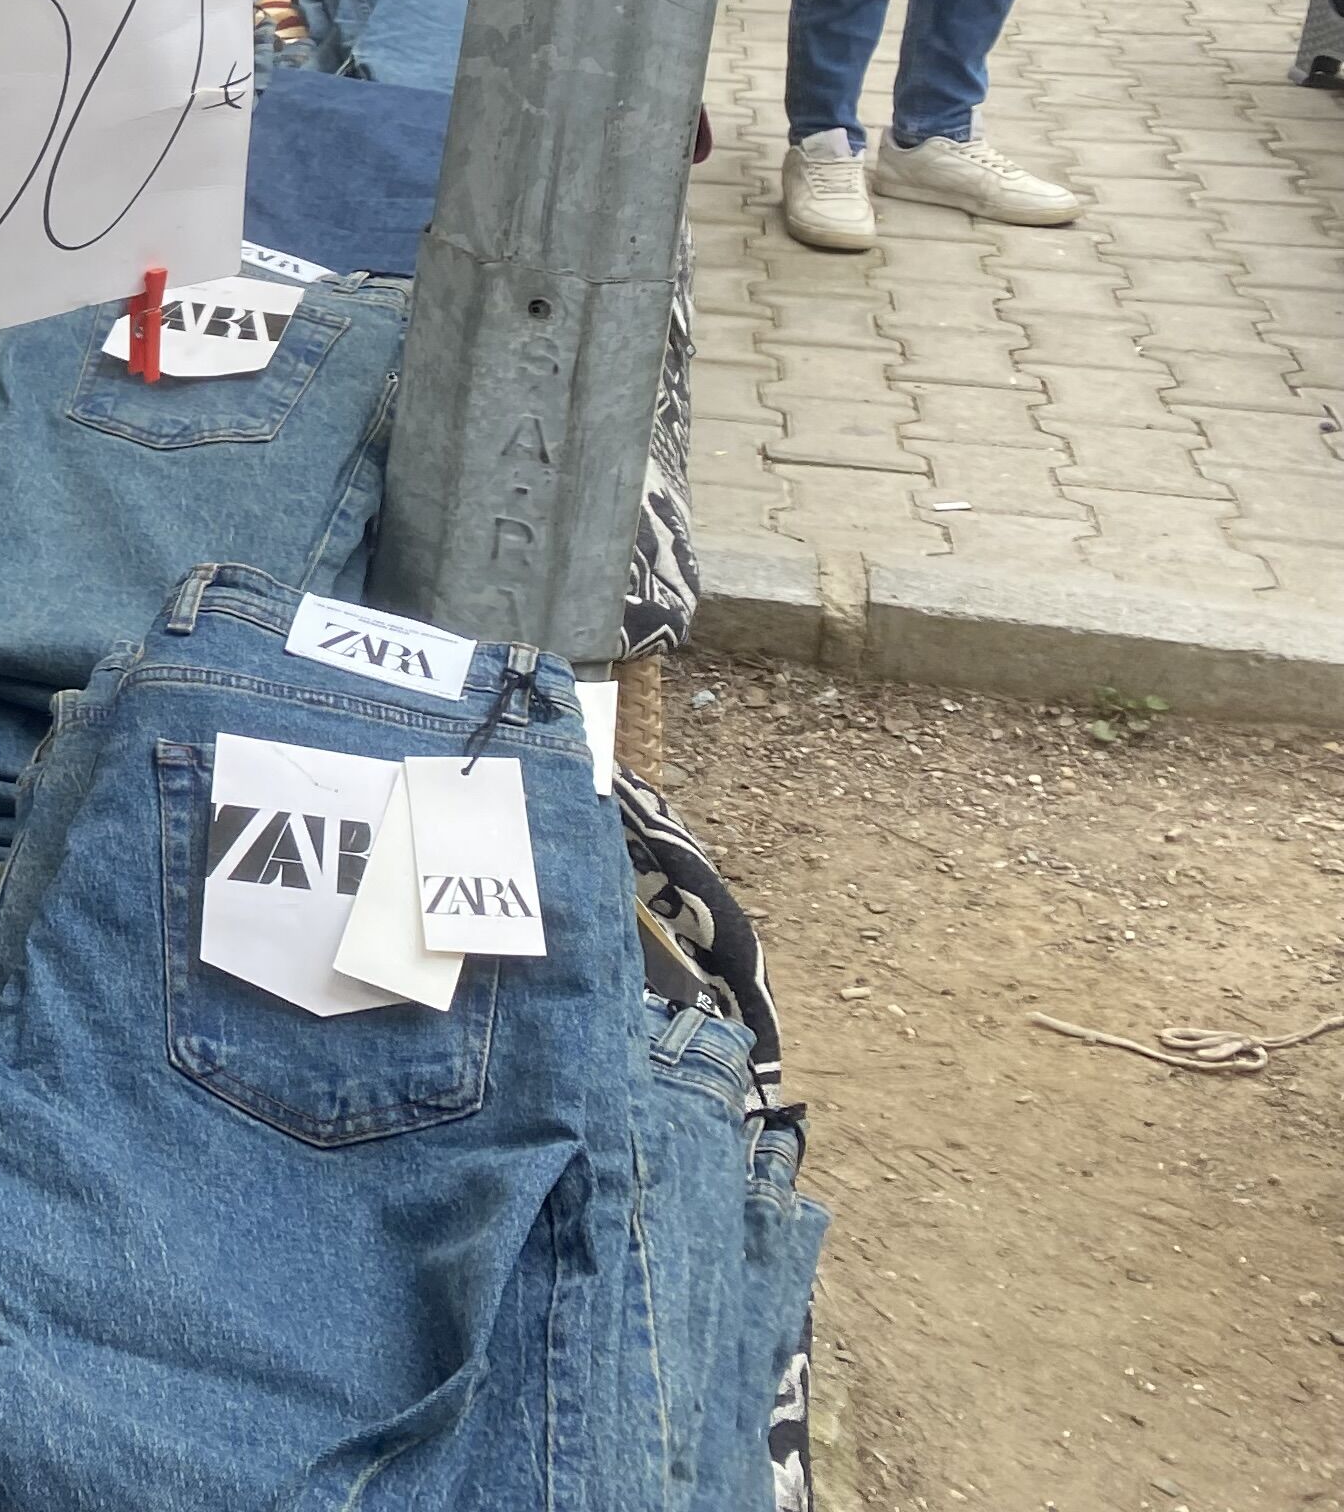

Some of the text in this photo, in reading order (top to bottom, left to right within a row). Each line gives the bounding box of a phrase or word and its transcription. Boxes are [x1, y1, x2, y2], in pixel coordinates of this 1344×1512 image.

[161, 300, 284, 342] ARA
[317, 621, 441, 681] ZARA
[422, 875, 540, 919] ZARA
